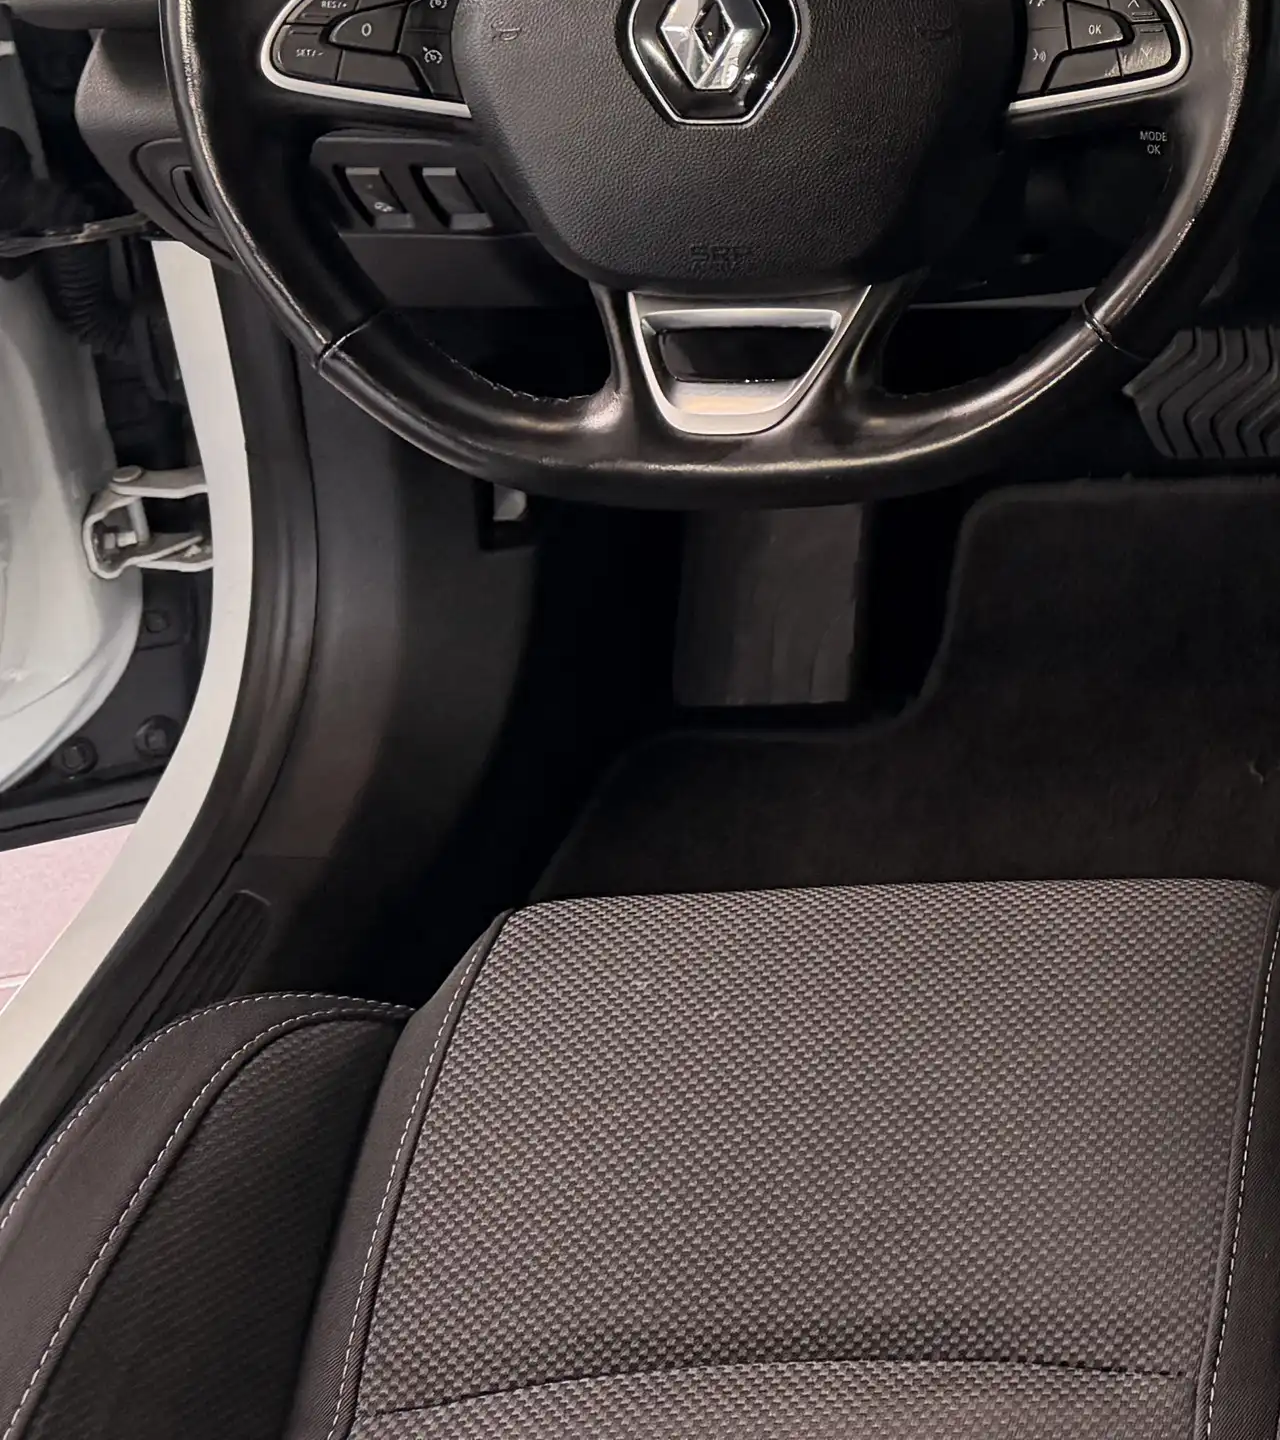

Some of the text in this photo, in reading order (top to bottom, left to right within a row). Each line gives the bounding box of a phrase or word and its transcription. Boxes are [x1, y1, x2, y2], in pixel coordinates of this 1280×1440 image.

[1088, 23, 1102, 36] OK
[1140, 130, 1168, 142] MODE
[1147, 143, 1161, 155] OK
